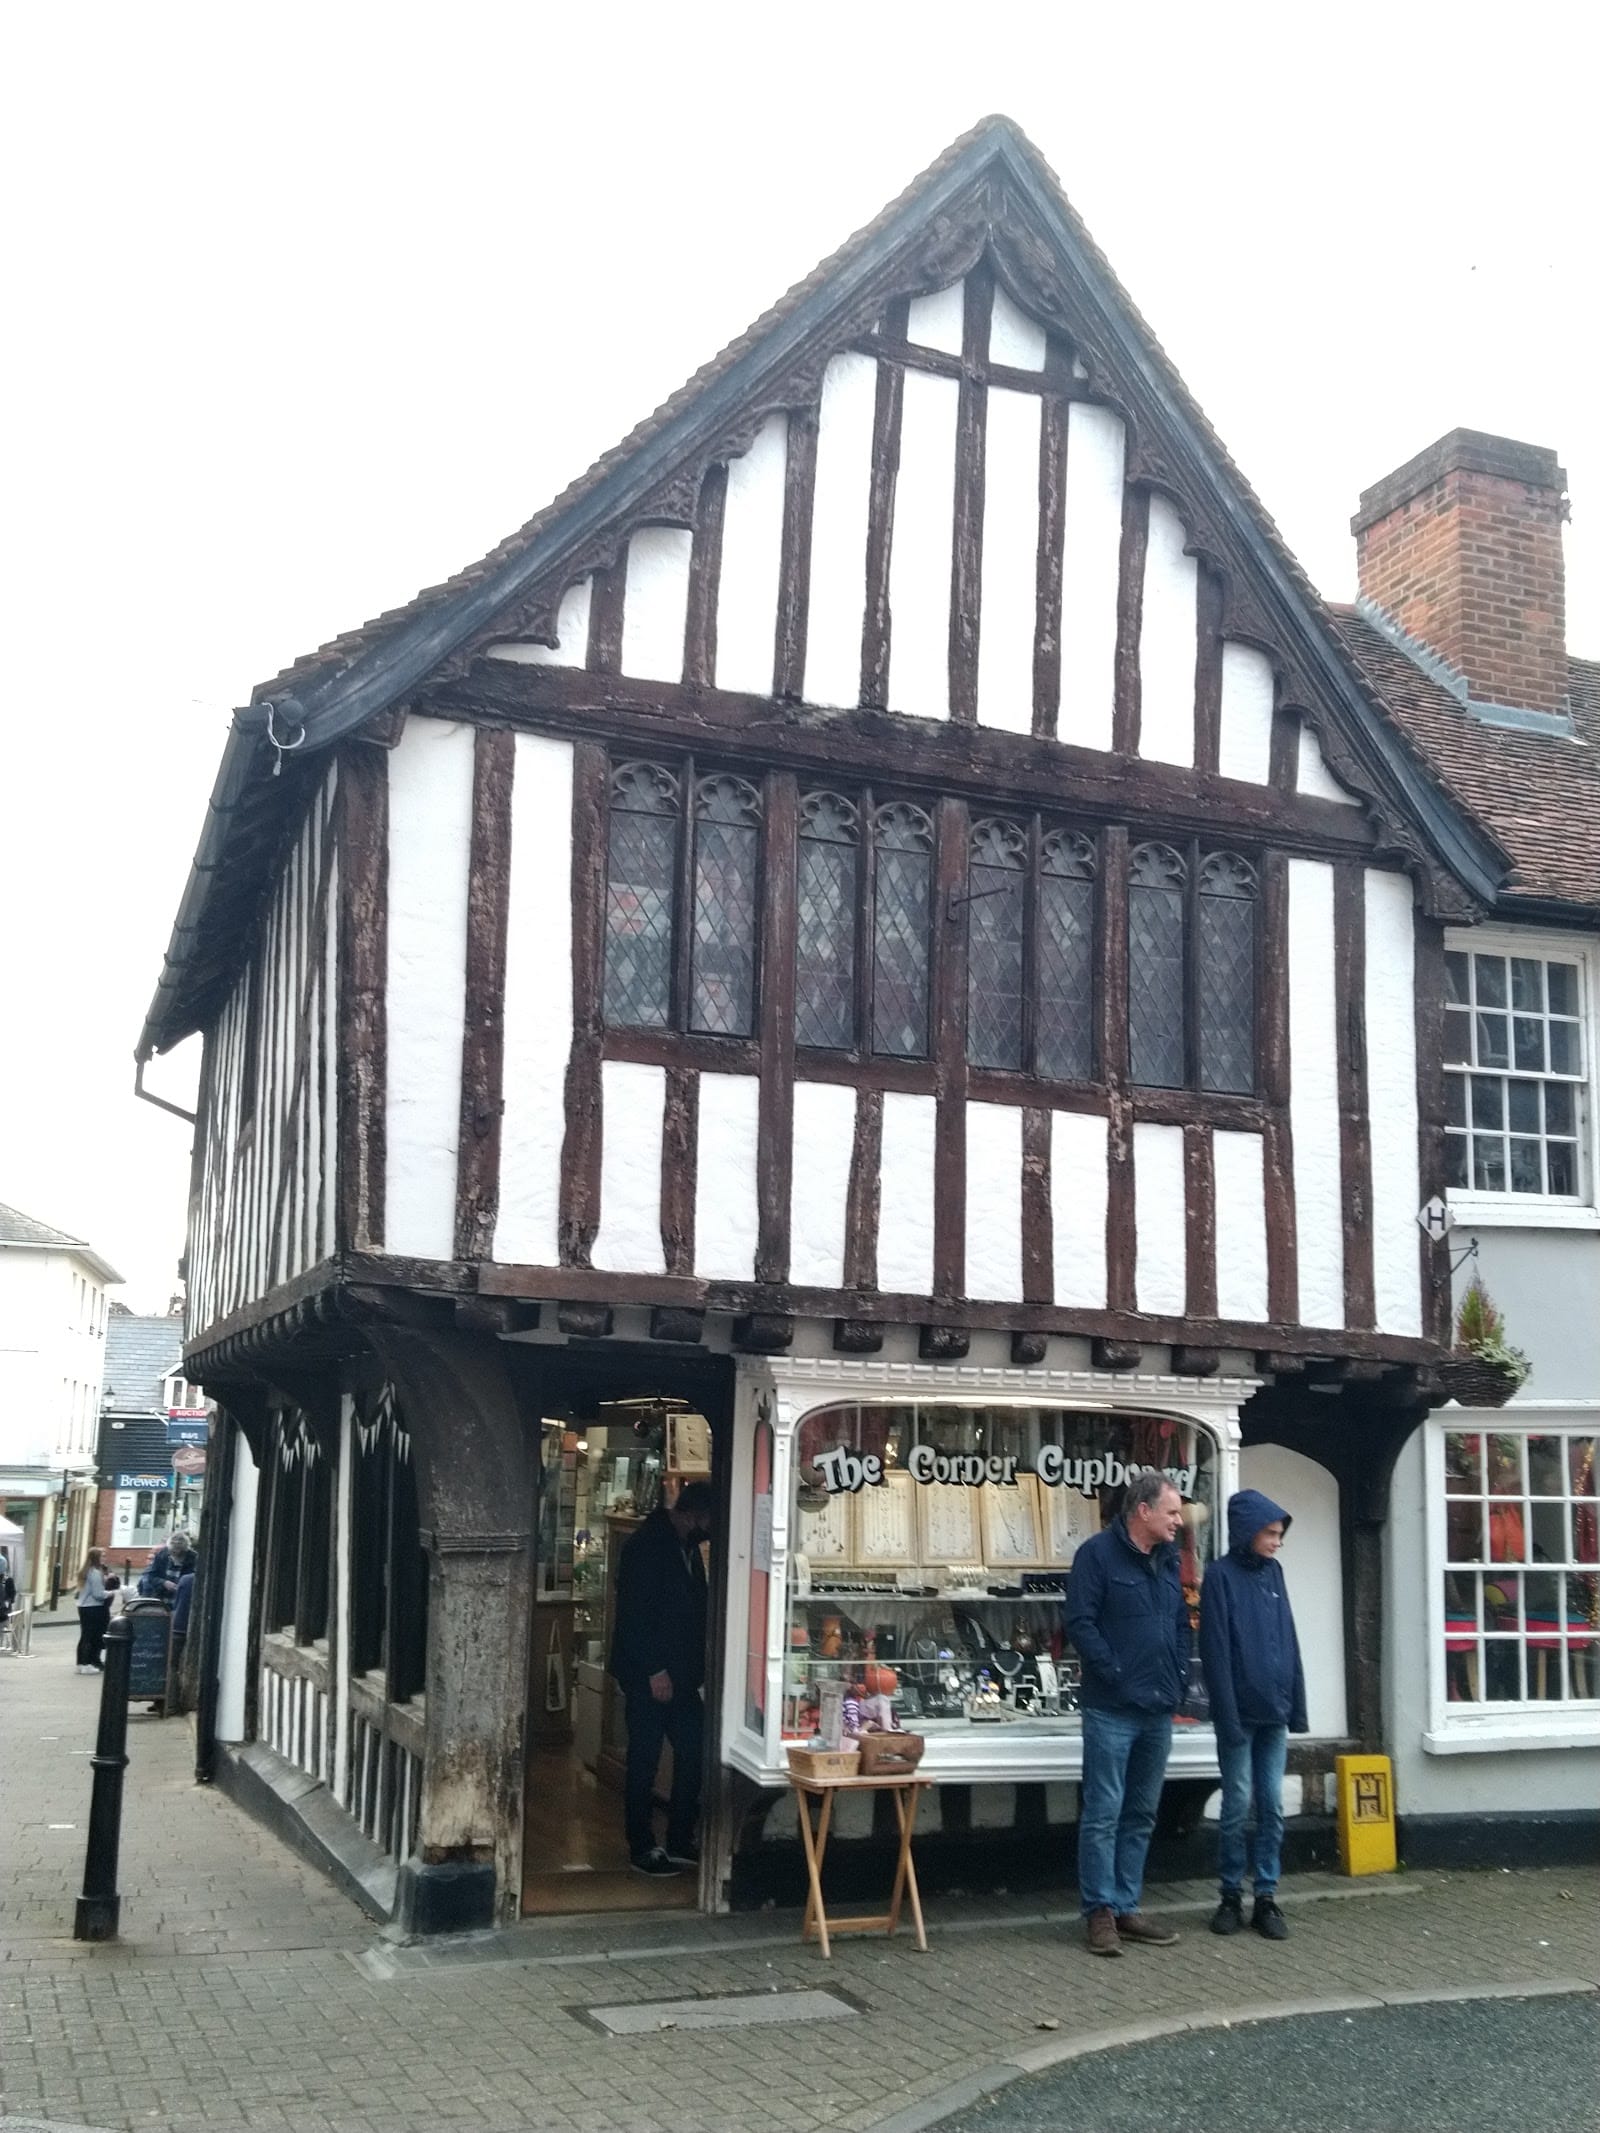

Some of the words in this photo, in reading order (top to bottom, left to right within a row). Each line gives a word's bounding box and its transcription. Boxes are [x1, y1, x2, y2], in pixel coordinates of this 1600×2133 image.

[1427, 1206, 1446, 1231] H
[120, 1474, 168, 1487] Brewers
[812, 1445, 885, 1494] The
[908, 1444, 1020, 1487] Corner
[1037, 1444, 1197, 1499] Cupbord
[1356, 1779, 1380, 1817] H
